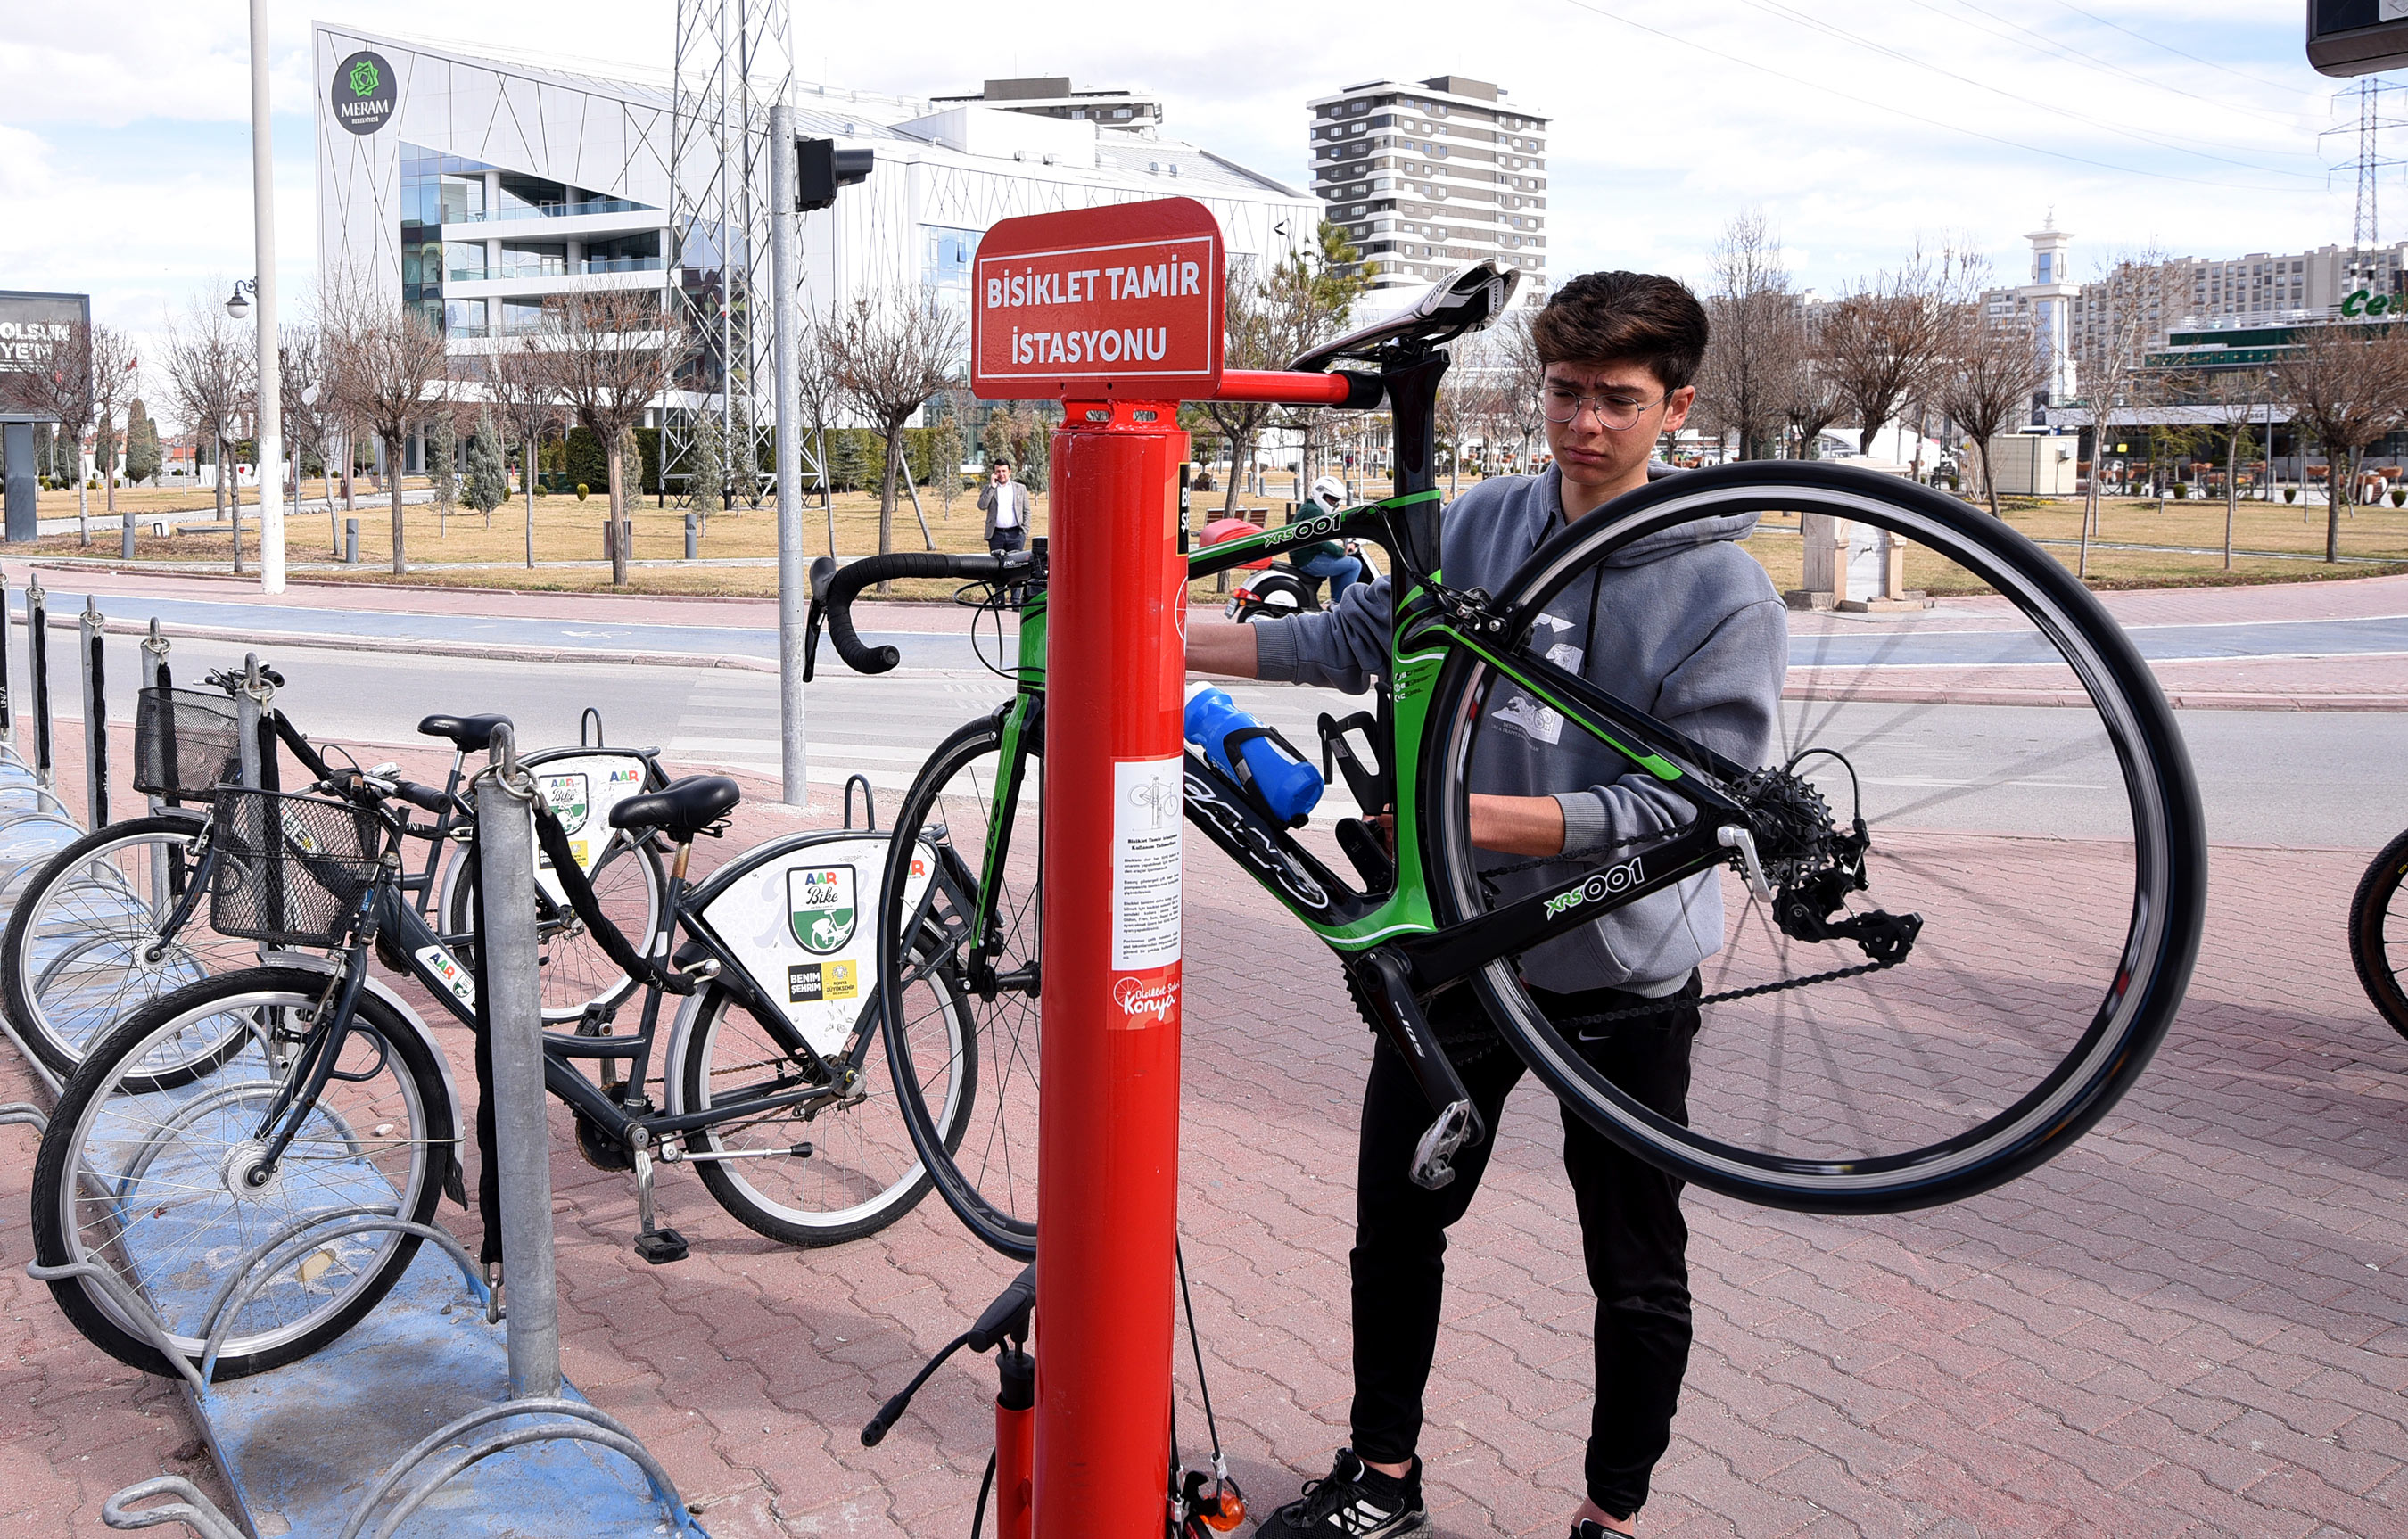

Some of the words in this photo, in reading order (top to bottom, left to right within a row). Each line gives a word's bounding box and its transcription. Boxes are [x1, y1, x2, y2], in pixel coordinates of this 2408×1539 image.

[341, 98, 389, 118] MERAM
[986, 267, 1100, 309] BİSİKLET
[1105, 254, 1200, 300] TAMİR
[1011, 325, 1167, 365] İSTASYONU
[609, 770, 639, 783] AAR
[804, 871, 837, 885] AAR
[1543, 856, 1645, 921] XRS001
[805, 886, 838, 905] Bike
[429, 952, 455, 980] AAR
[789, 972, 821, 984] BENİM
[790, 983, 821, 995] ŞEHRİM
[1124, 992, 1176, 1021] Konya
[1402, 1019, 1425, 1058] 105
